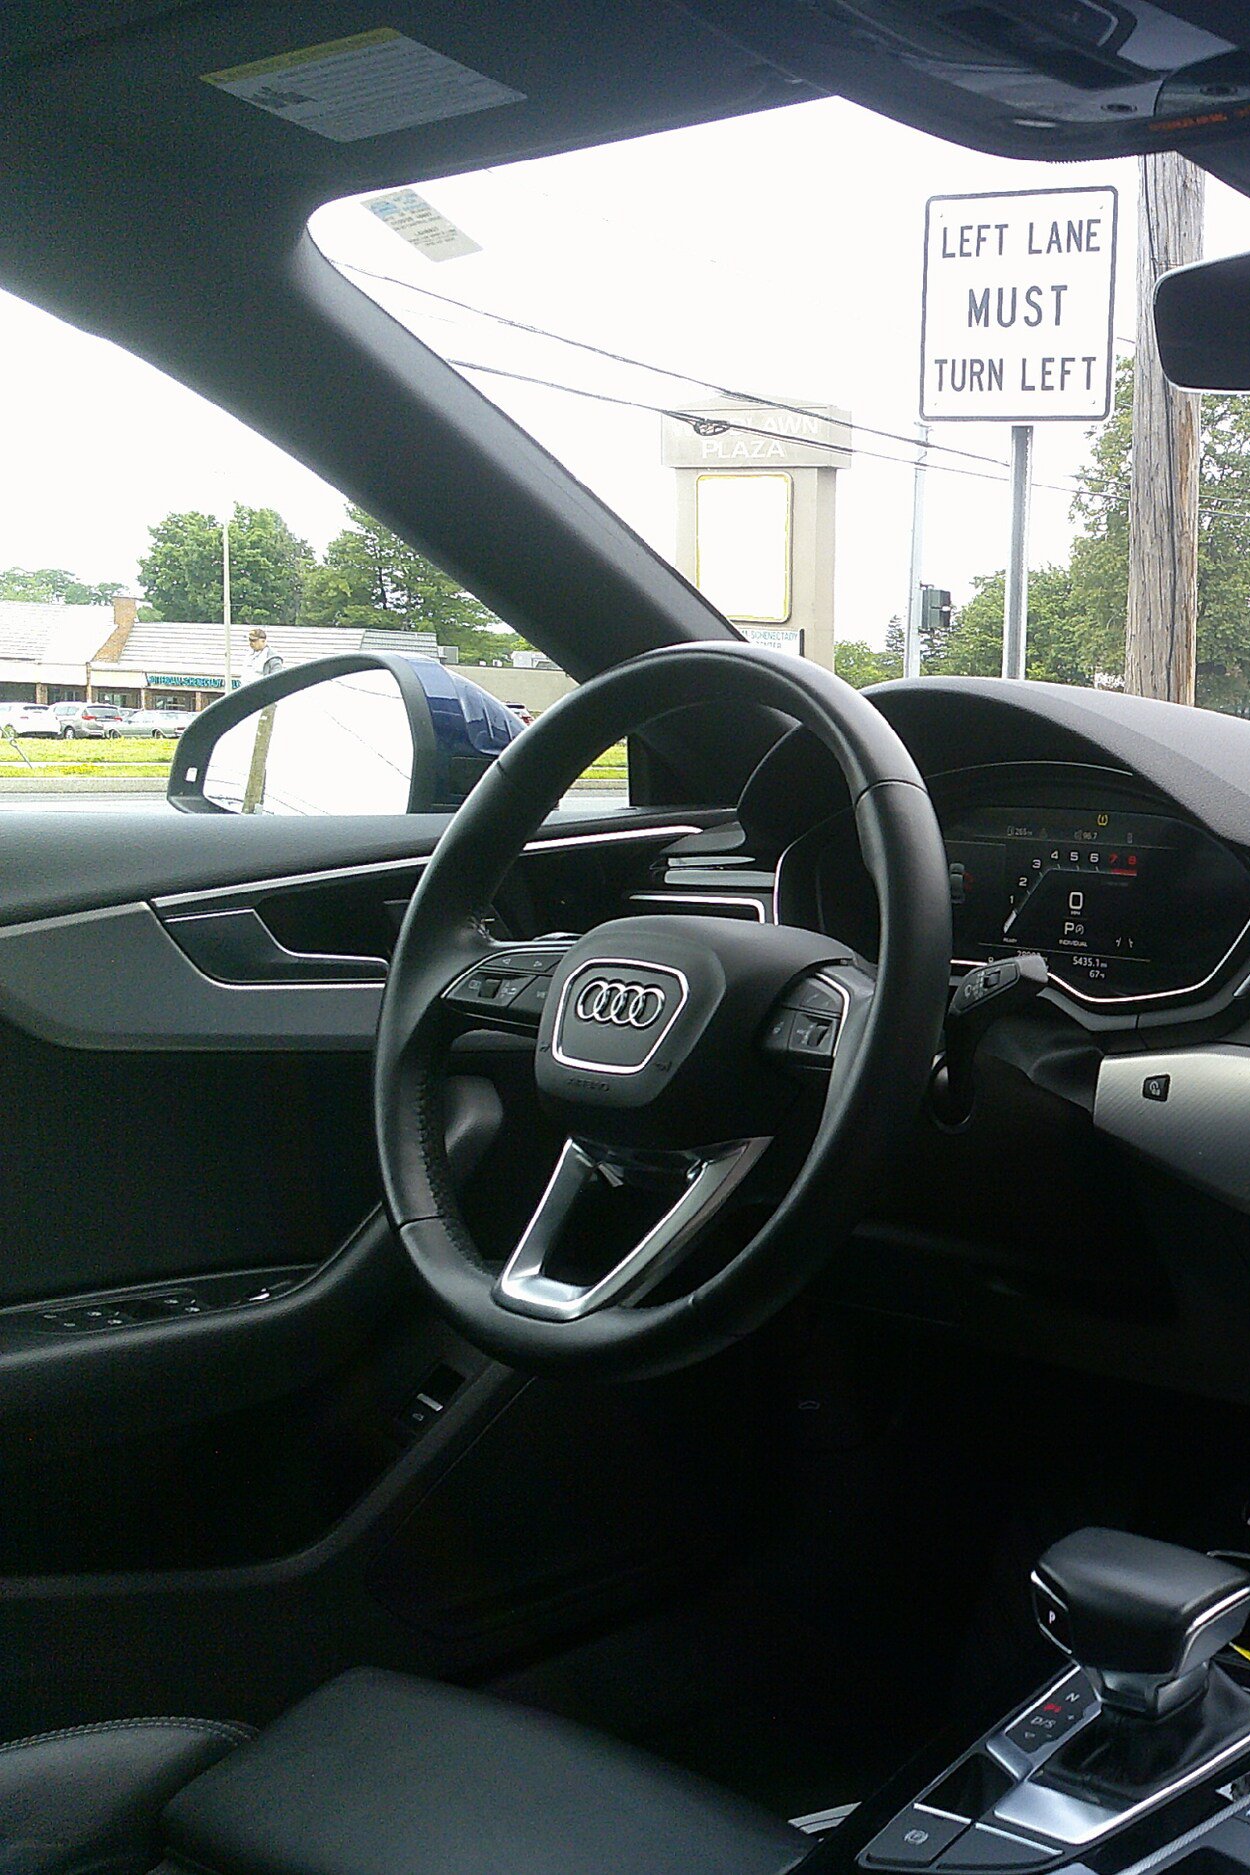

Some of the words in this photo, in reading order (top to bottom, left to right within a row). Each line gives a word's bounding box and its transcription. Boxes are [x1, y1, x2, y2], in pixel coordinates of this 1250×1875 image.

[942, 224, 1009, 258] LEFT
[1028, 219, 1101, 255] LANE
[968, 285, 1068, 328] MUST
[934, 358, 1003, 392] TURN
[1021, 356, 1097, 391] LEFT
[701, 439, 786, 459] PLAZA
[1050, 850, 1059, 860] 4
[1070, 851, 1079, 862] 5
[1089, 853, 1099, 863] 6
[1127, 855, 1137, 865] 8
[1032, 859, 1042, 869] 3
[1018, 877, 1028, 887] 2
[1009, 895, 1015, 904] 1
[1068, 891, 1084, 910] 0
[1064, 921, 1075, 935] P
[1049, 1609, 1056, 1624] P
[1064, 1692, 1080, 1703] N
